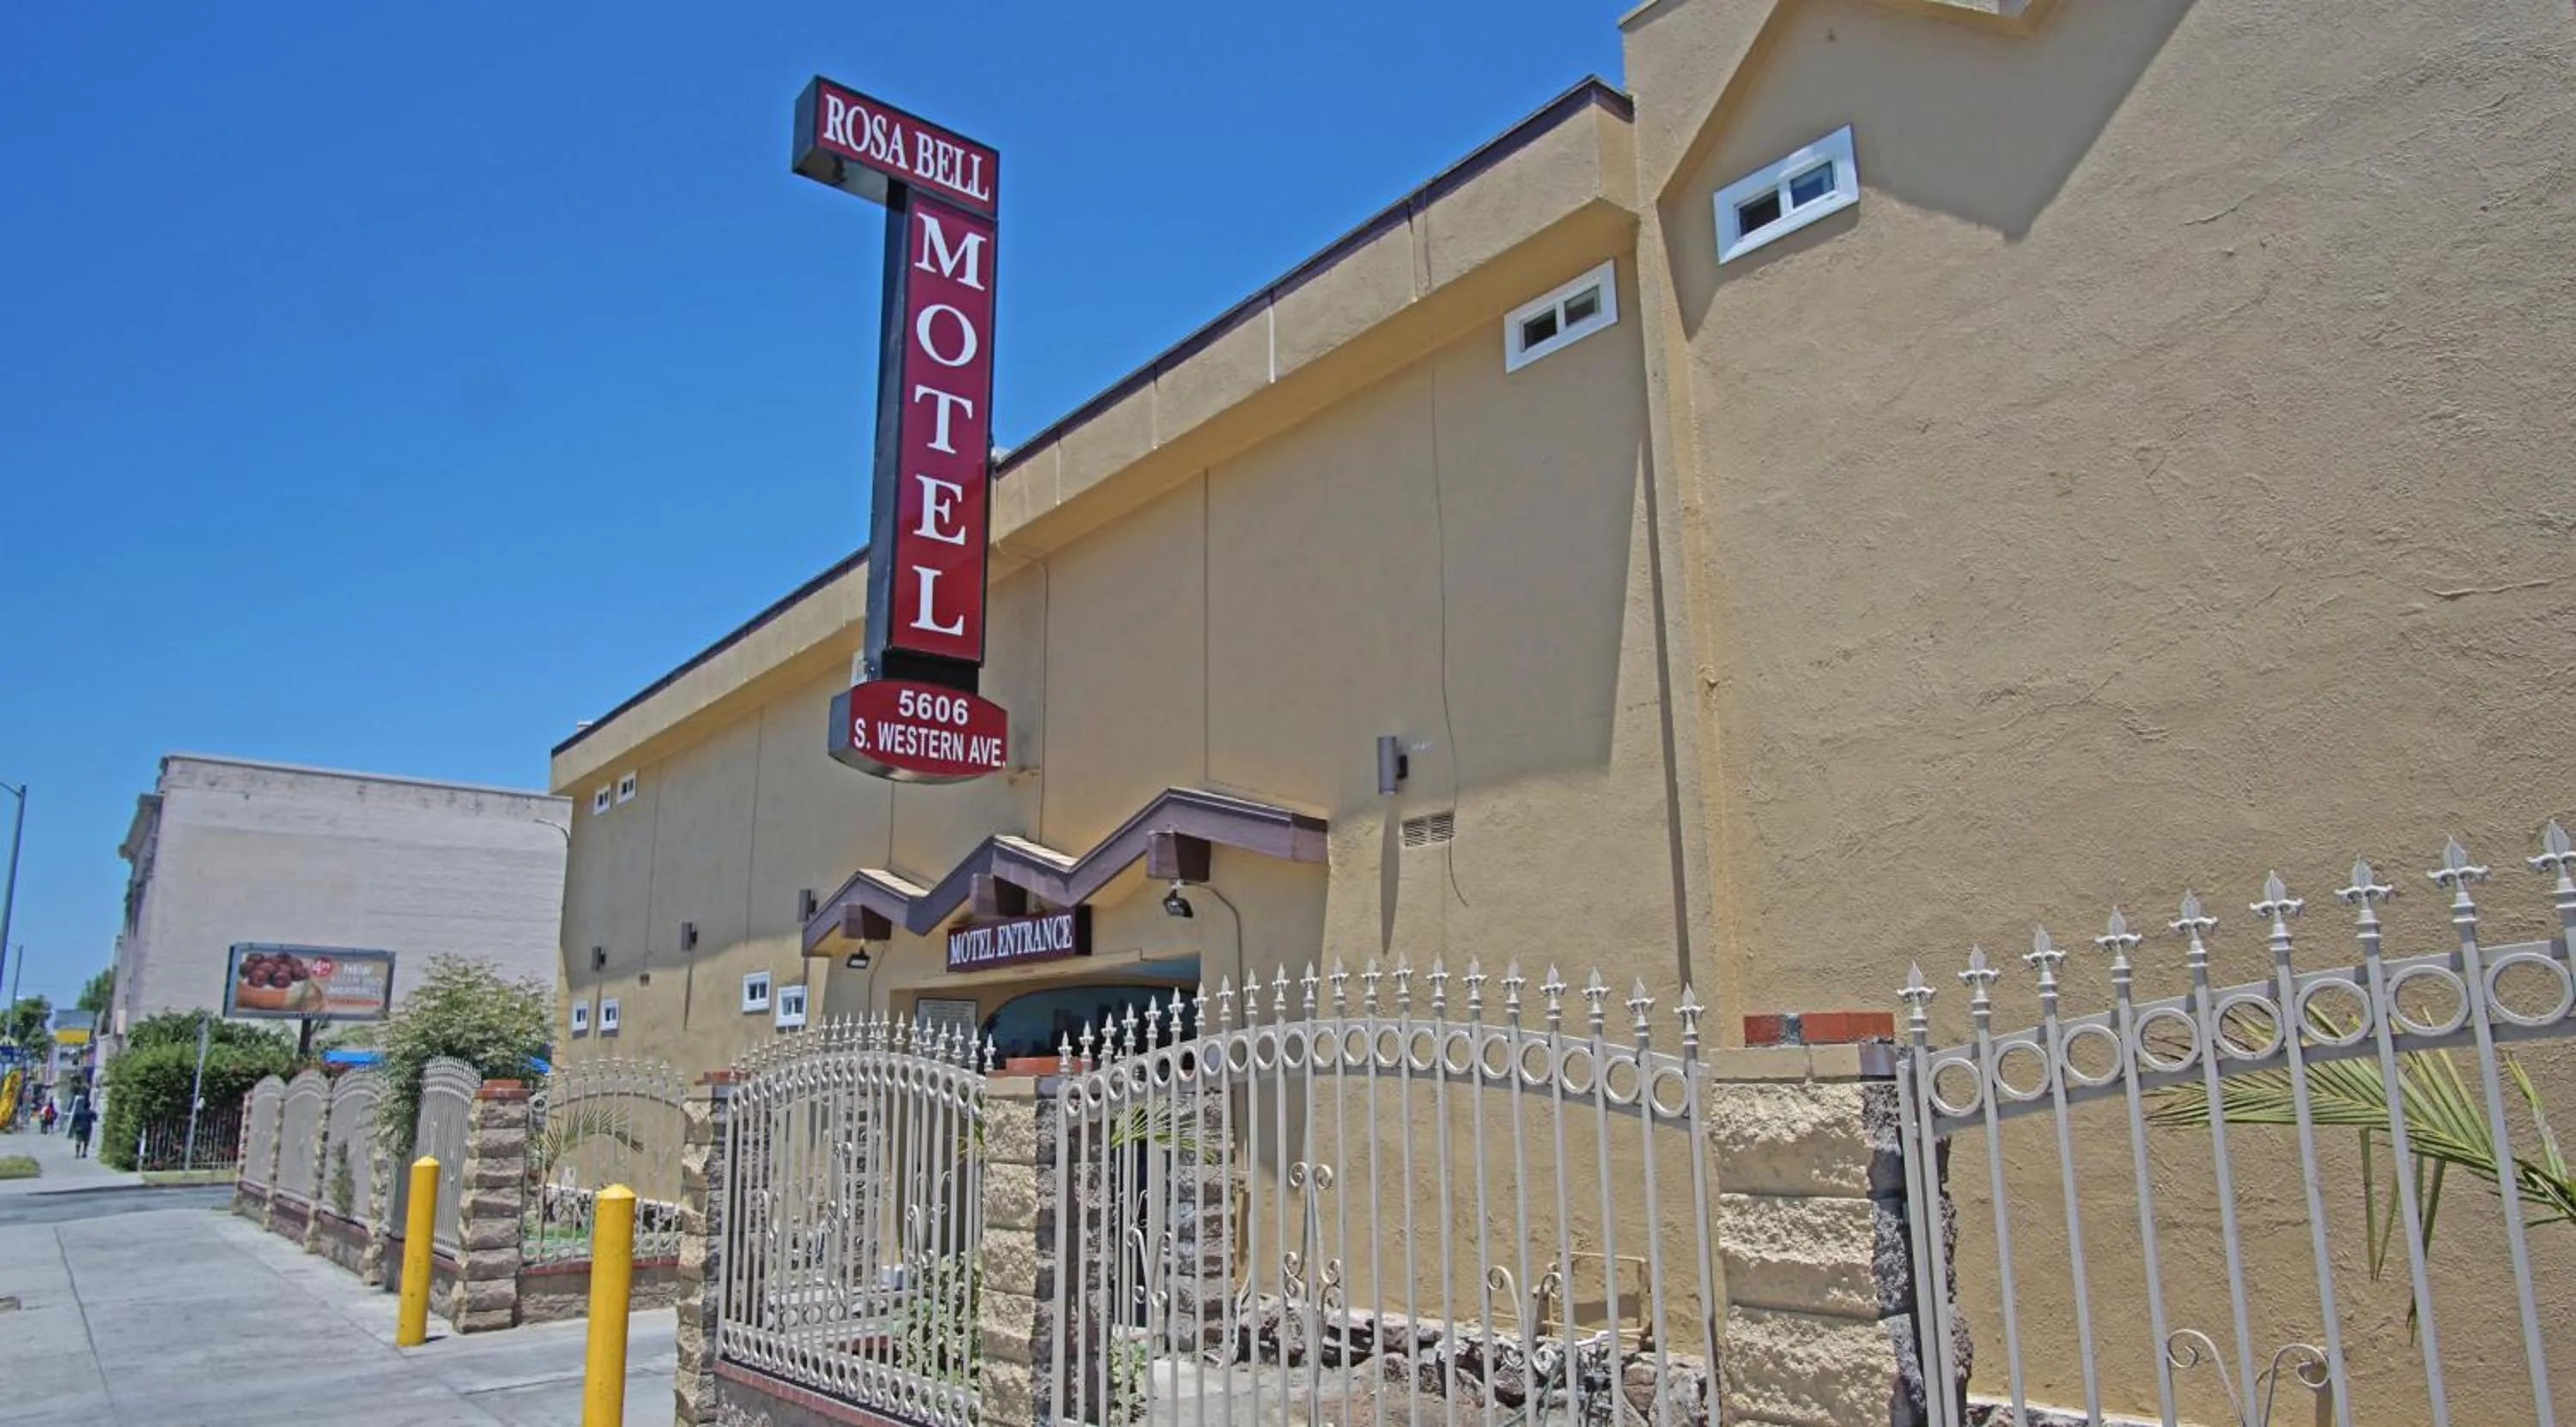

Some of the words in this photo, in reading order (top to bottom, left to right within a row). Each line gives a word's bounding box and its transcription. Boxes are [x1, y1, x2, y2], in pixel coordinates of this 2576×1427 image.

[823, 94, 908, 170] ROSA
[913, 131, 989, 202] BELL
[910, 211, 987, 636] MOTEL
[898, 689, 969, 726] 5606
[854, 718, 871, 750] S.
[878, 721, 963, 762] WESTERN
[969, 735, 1006, 768] AVE.
[950, 929, 994, 965] MOTEL
[996, 914, 1072, 957] ENTRANCE
